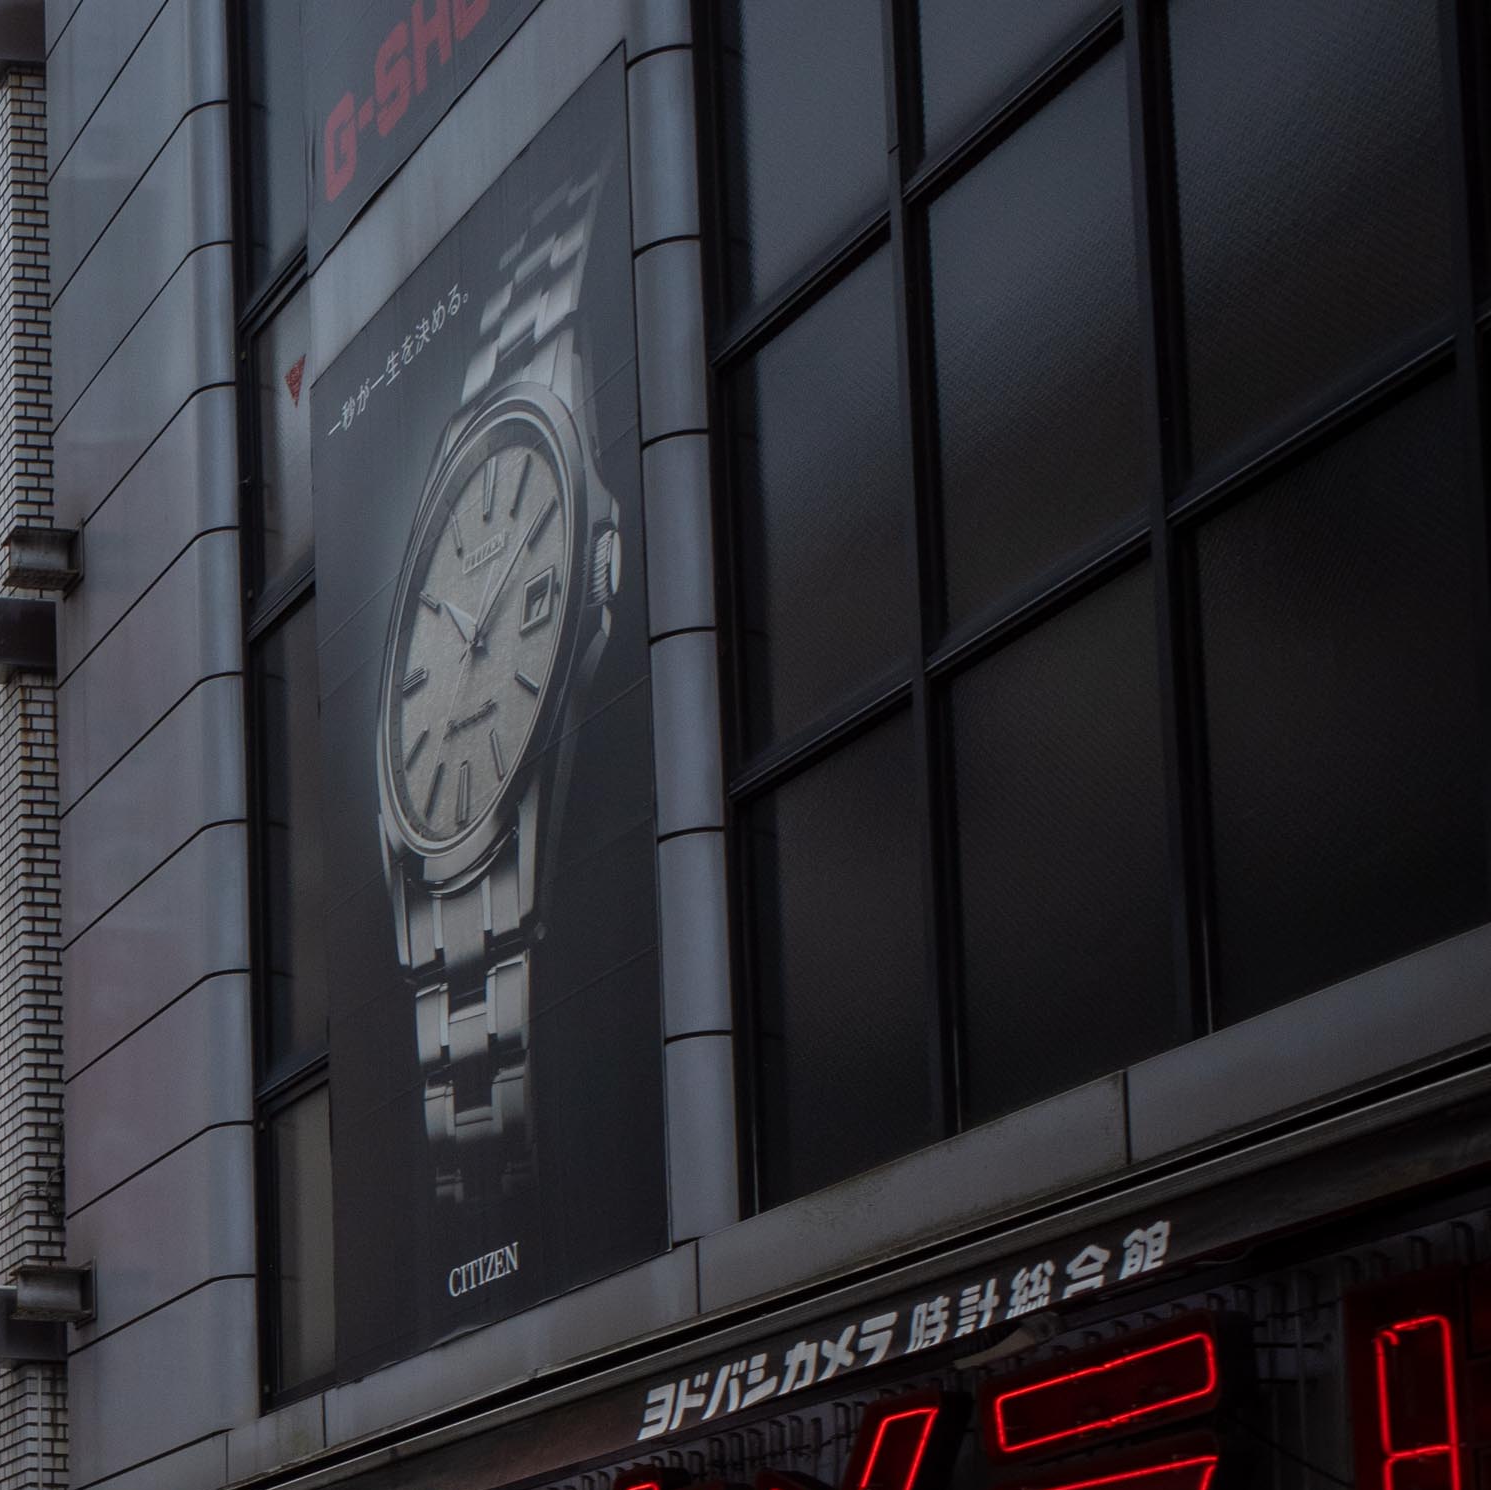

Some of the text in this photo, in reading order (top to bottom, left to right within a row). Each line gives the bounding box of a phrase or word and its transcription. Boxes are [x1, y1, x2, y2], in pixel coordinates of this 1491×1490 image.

[328, 283, 470, 437] 一秒が一生を決める。
[448, 1240, 521, 1299] CITIZEN
[637, 1219, 1171, 1440] ヨドバシカメラ 時計総合館
